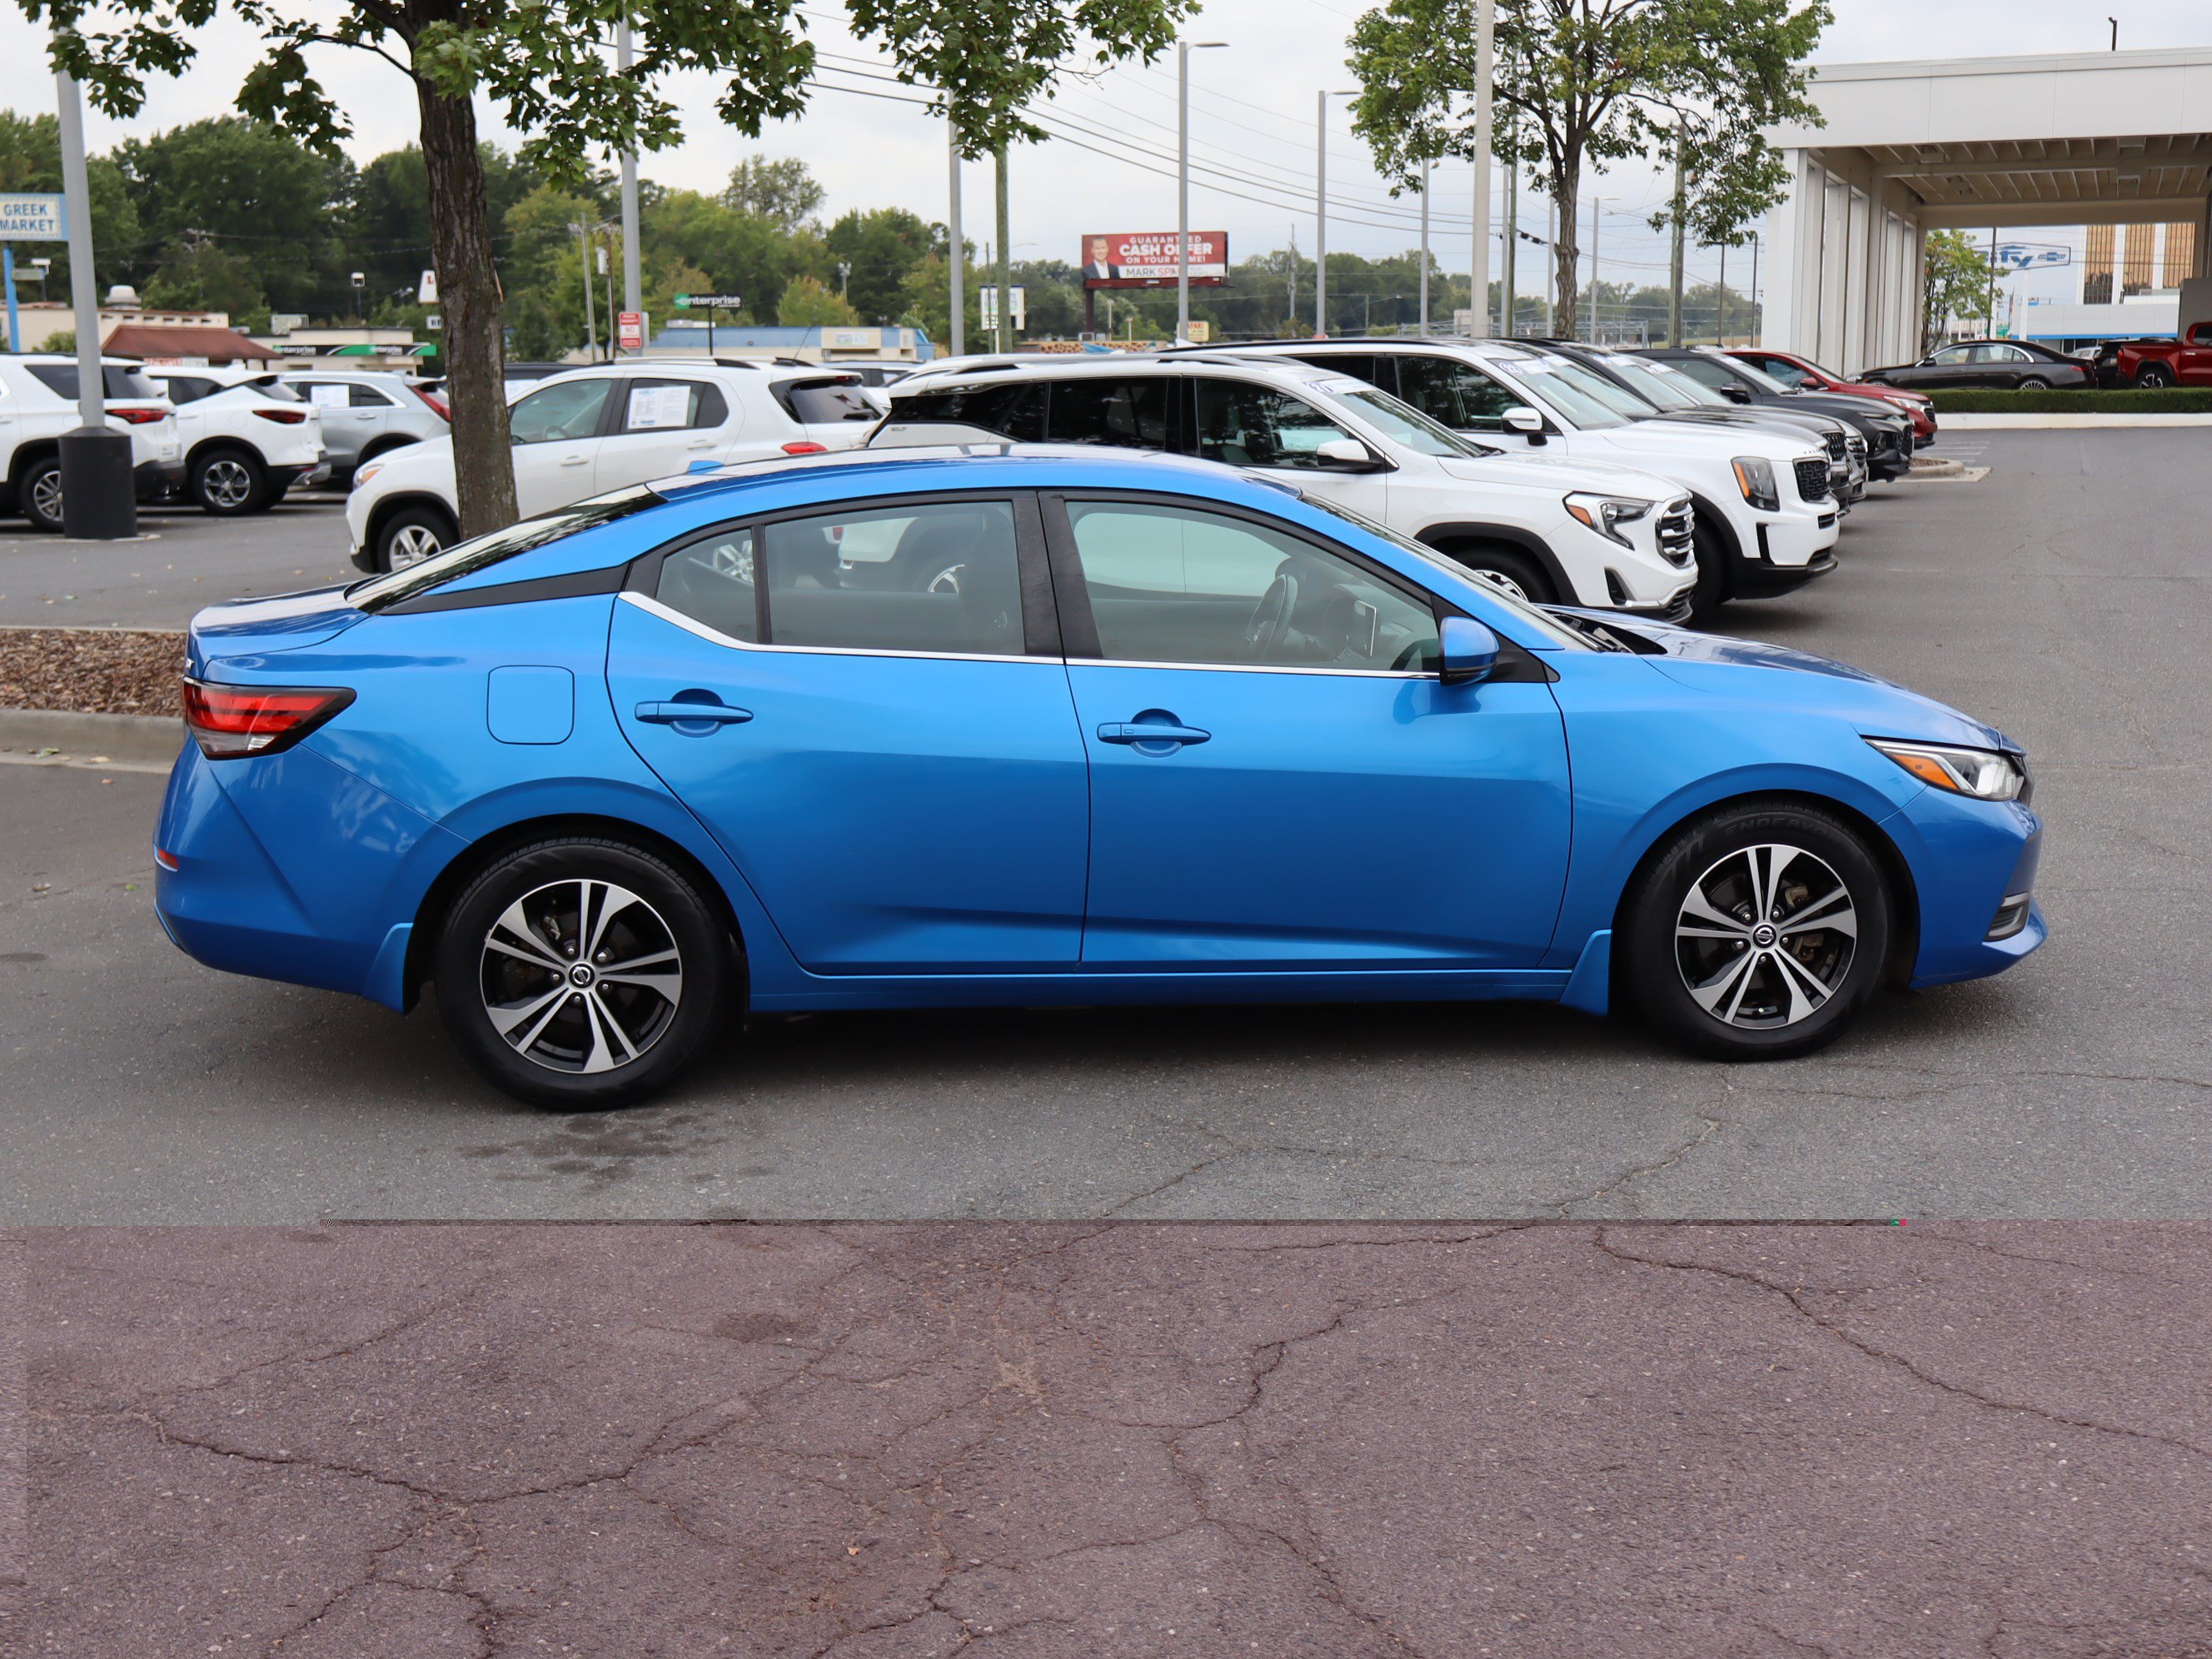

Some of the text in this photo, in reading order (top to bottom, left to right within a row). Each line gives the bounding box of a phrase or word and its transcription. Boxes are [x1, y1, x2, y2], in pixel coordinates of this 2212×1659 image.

[4, 204, 47, 217] GREEK
[0, 219, 54, 232] MARKET
[1129, 235, 1202, 244] GUARANTED
[1119, 244, 1160, 256] CASH
[1127, 268, 1156, 276] MARK
[678, 295, 741, 306] enterprise
